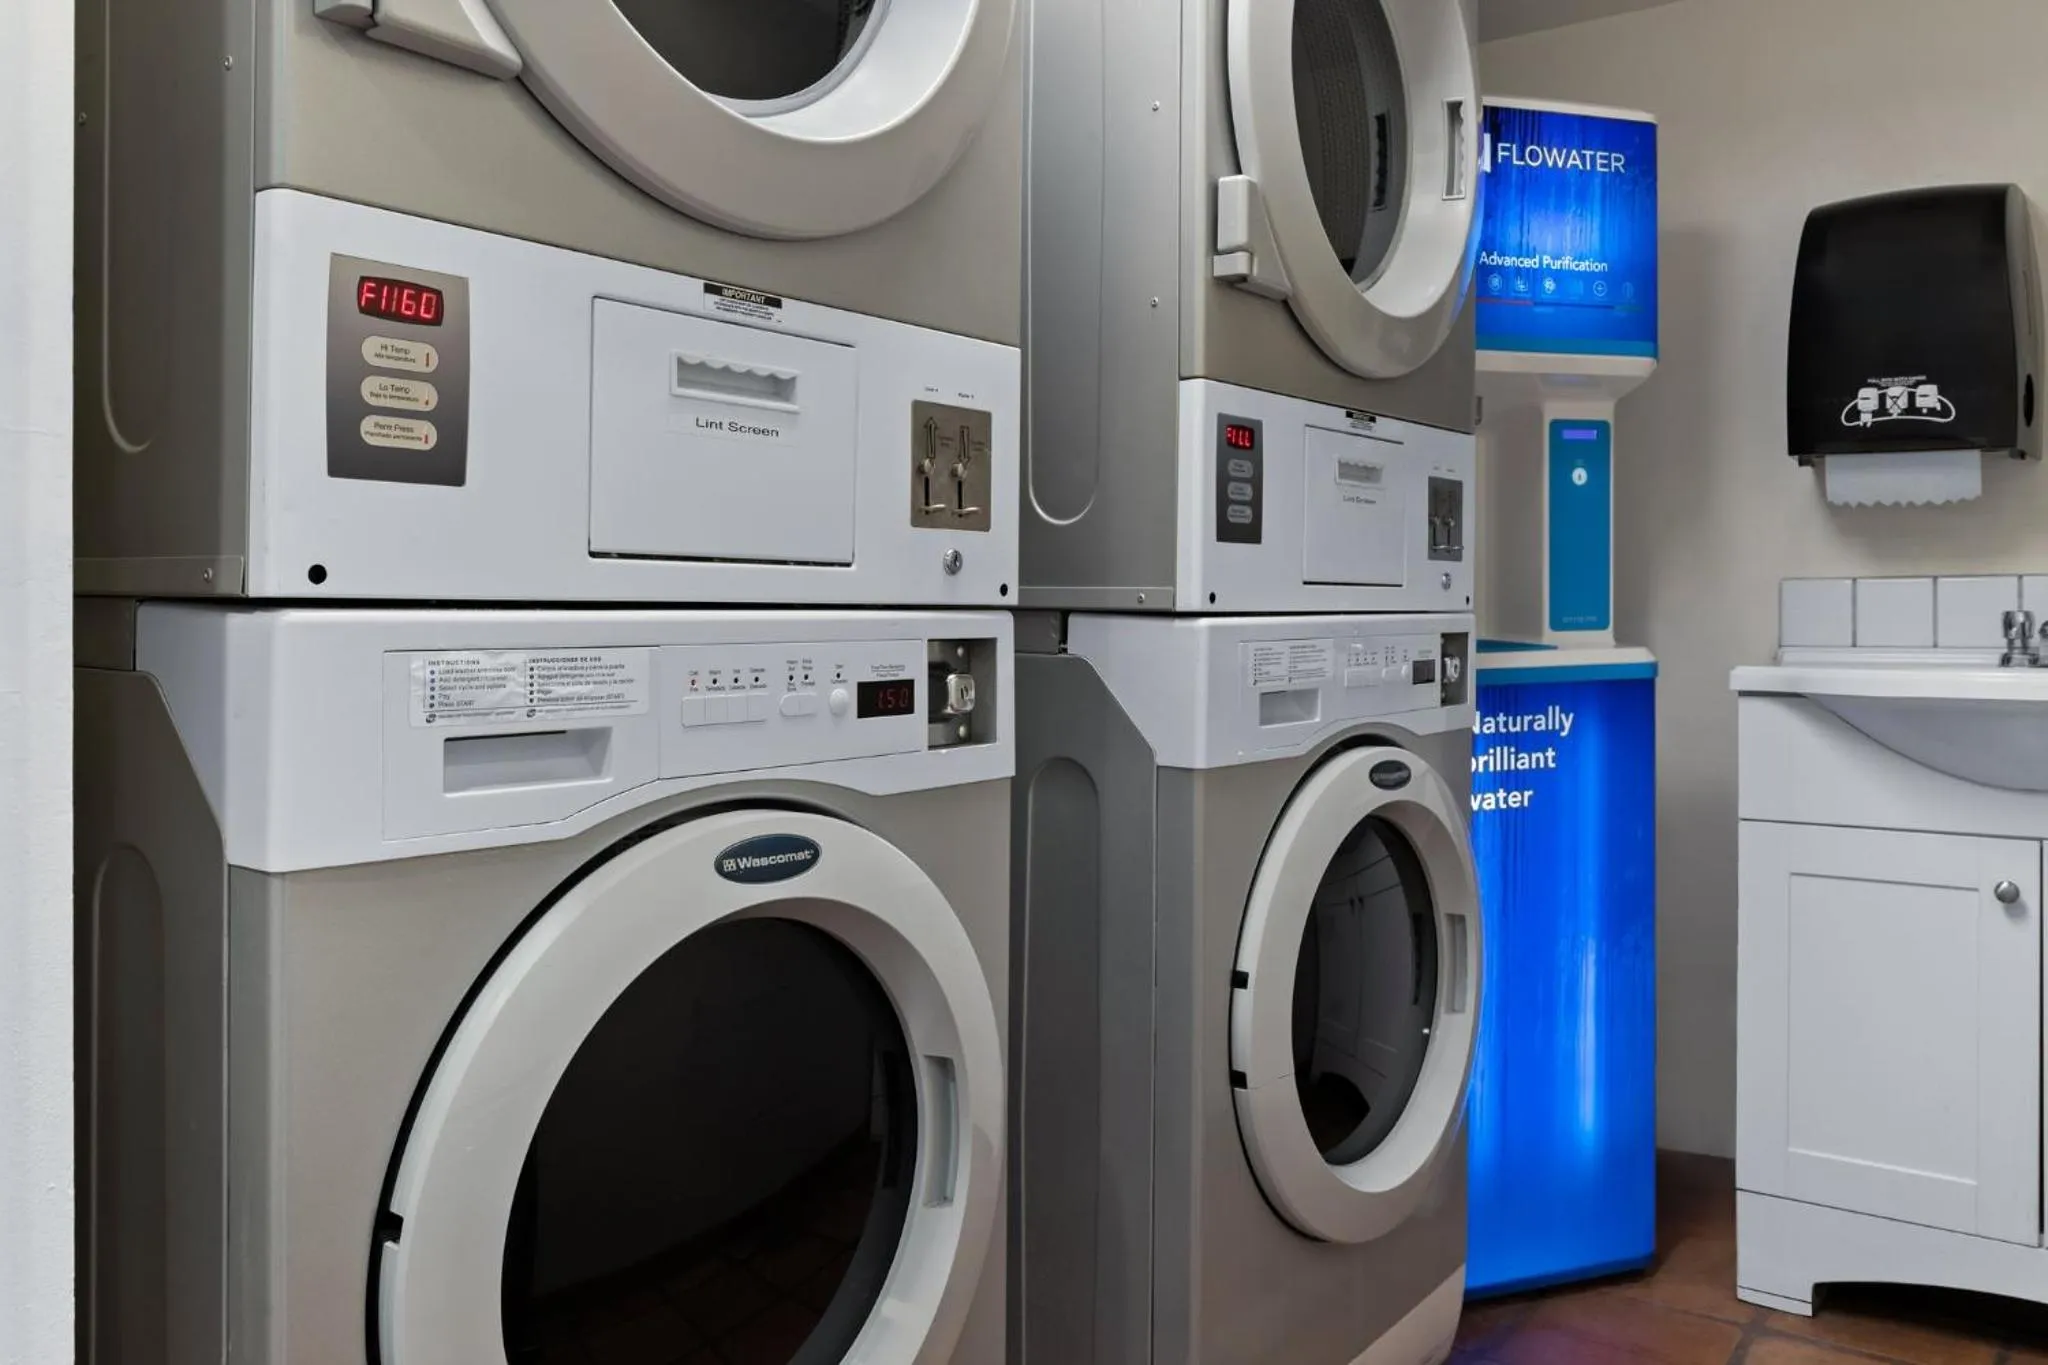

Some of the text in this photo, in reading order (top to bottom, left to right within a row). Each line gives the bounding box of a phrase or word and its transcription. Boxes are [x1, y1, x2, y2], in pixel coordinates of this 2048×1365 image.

[1497, 143, 1625, 173] FLOWATER
[1479, 251, 1608, 272] Advanced Purification
[721, 287, 766, 304] IMPORTANT
[695, 416, 779, 437] Lint Screen
[737, 849, 812, 869] Wascomat
